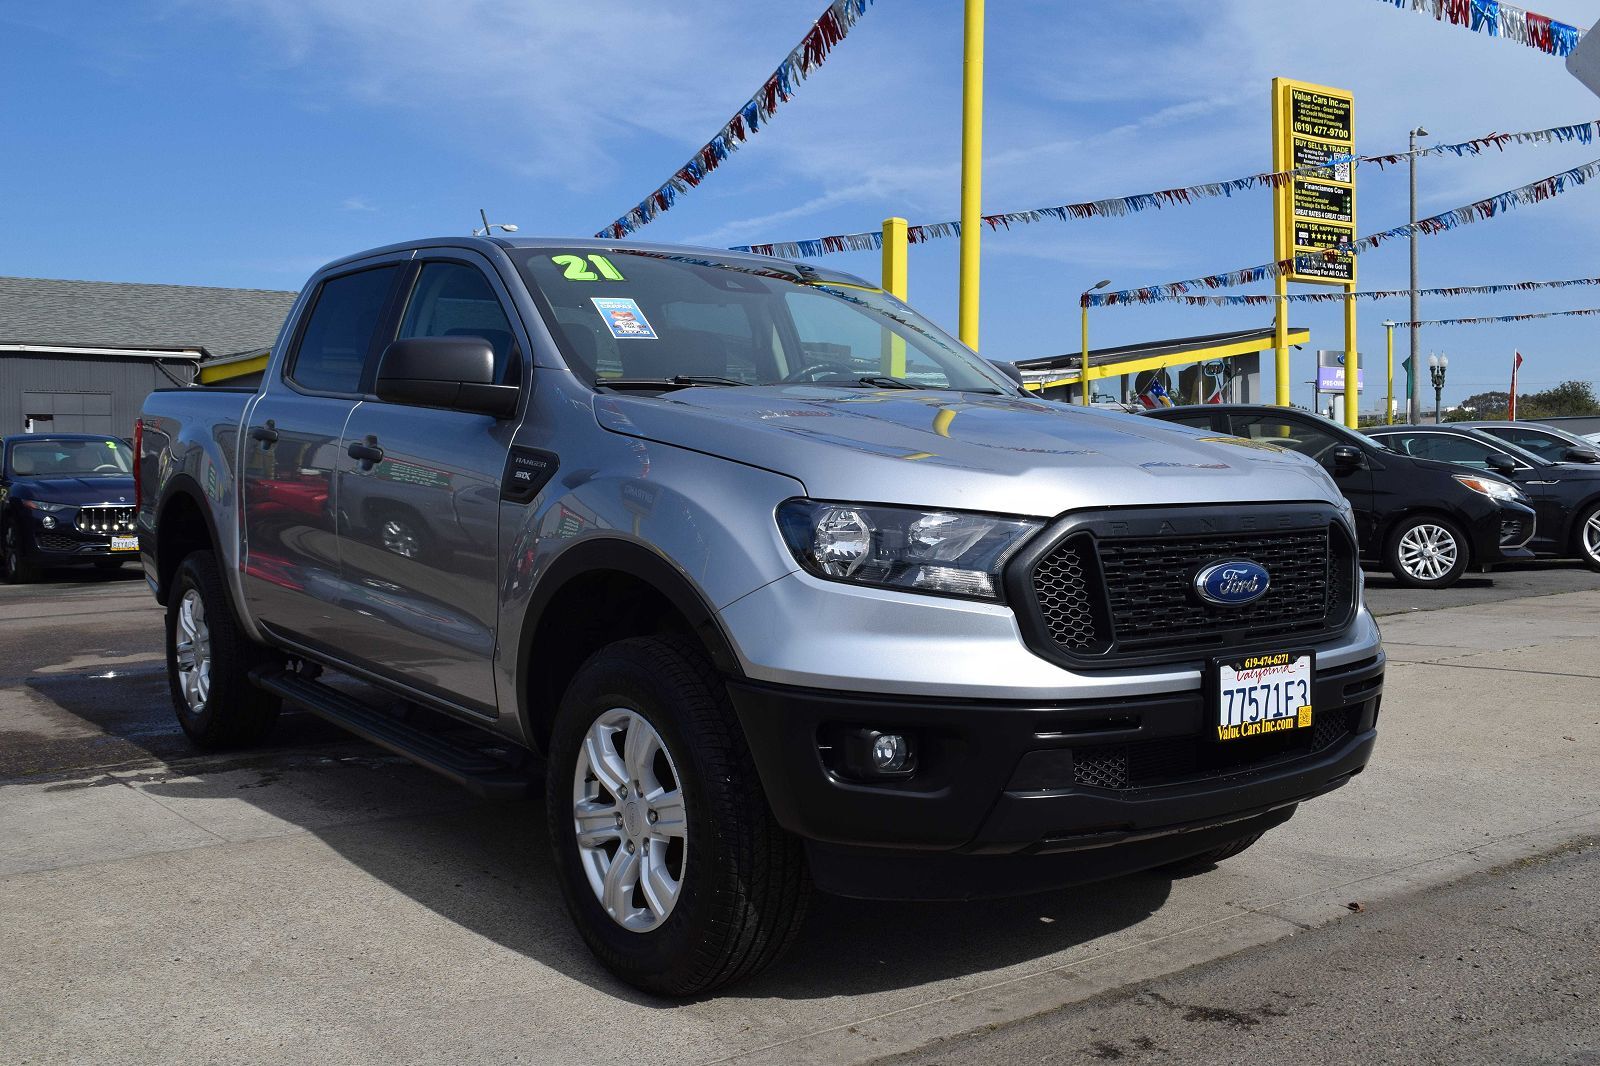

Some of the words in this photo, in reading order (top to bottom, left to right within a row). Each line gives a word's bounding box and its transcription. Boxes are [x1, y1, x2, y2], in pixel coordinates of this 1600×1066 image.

[1294, 91, 1311, 101] Value
[1313, 95, 1327, 105] Cars
[1329, 98, 1349, 108] Inc.com
[1295, 122, 1312, 134] (619)
[1314, 126, 1348, 138] 477-9700
[1296, 139, 1306, 147] BUY
[1308, 142, 1322, 150] SELL
[1304, 183, 1333, 192] Financiamos
[552, 254, 624, 280] 21
[1106, 513, 1324, 535] RANGER
[1220, 569, 1258, 594] Ford
[1245, 654, 1289, 668] 619-474-6271
[1223, 679, 1307, 725] 77571F3
[1241, 721, 1260, 737] Cars
[1262, 718, 1293, 733] Inc.com
